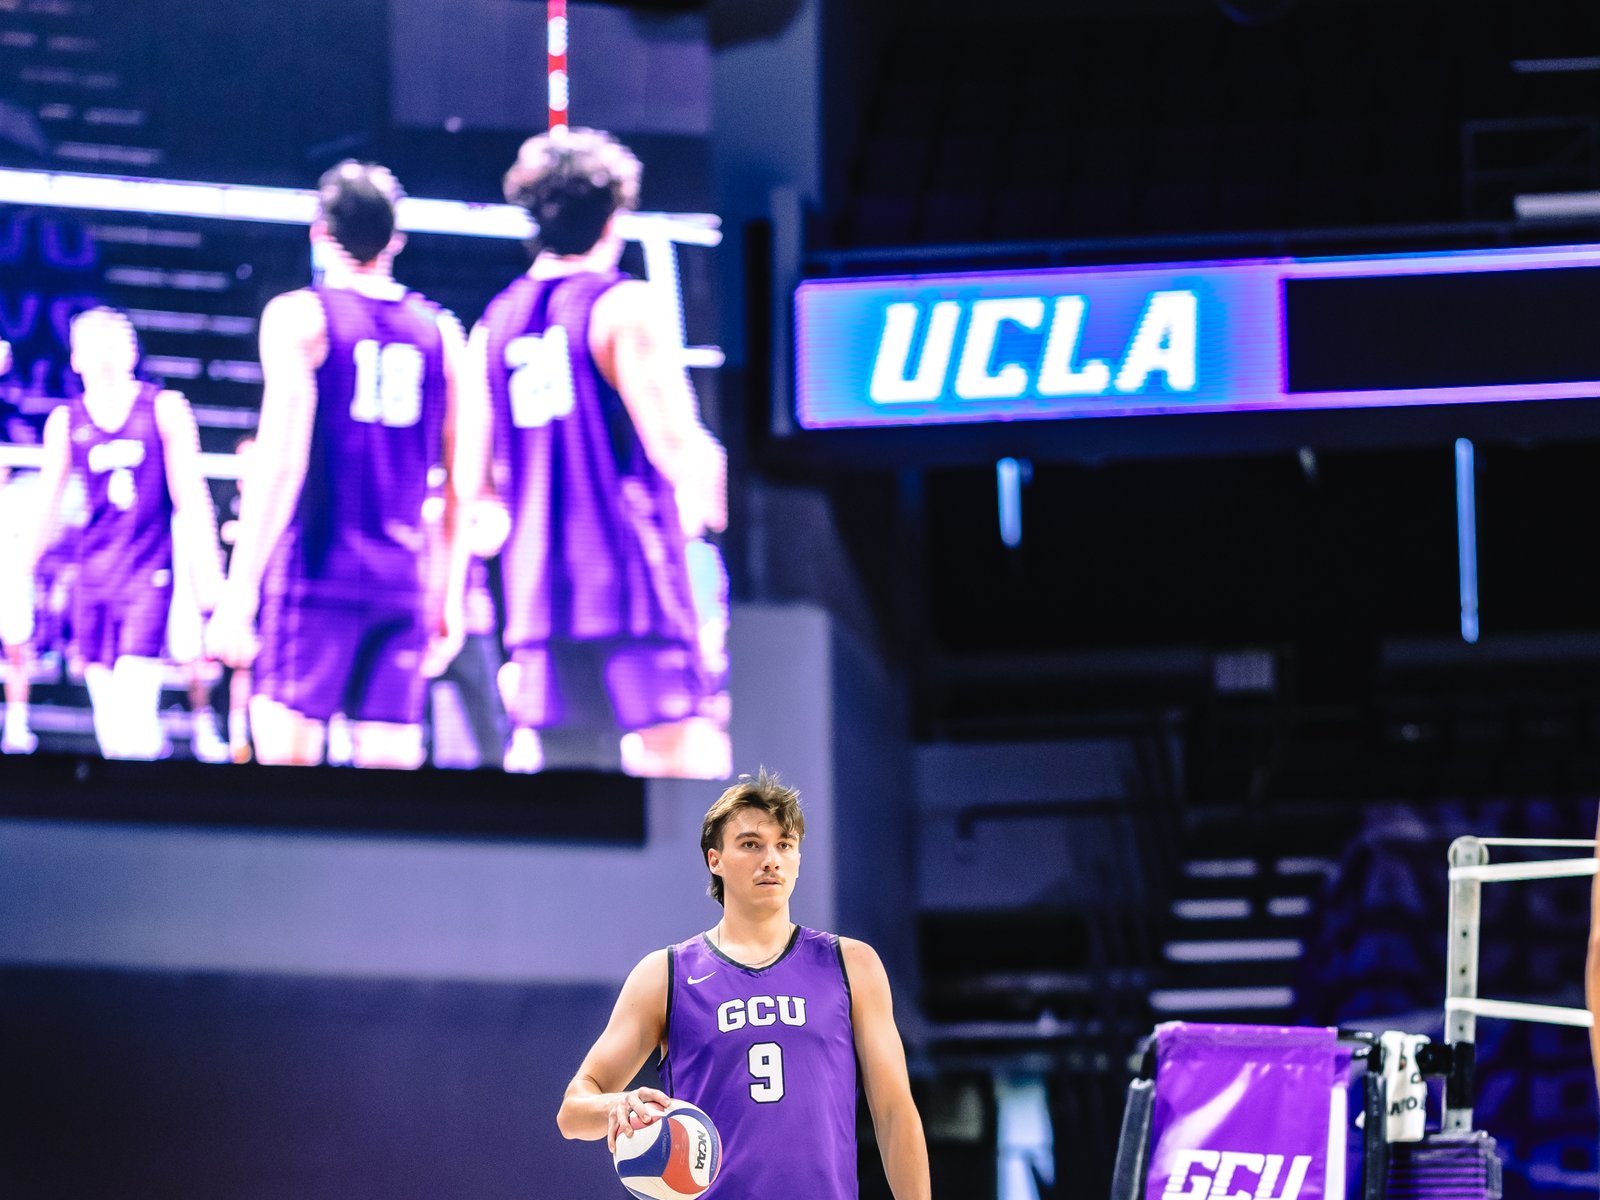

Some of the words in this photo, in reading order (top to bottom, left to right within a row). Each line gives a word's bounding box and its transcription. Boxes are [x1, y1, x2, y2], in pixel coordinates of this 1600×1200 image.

[868, 289, 1198, 403] UCLA
[716, 994, 808, 1034] GCU
[747, 1041, 786, 1104] 9
[695, 1129, 708, 1170] NCAA
